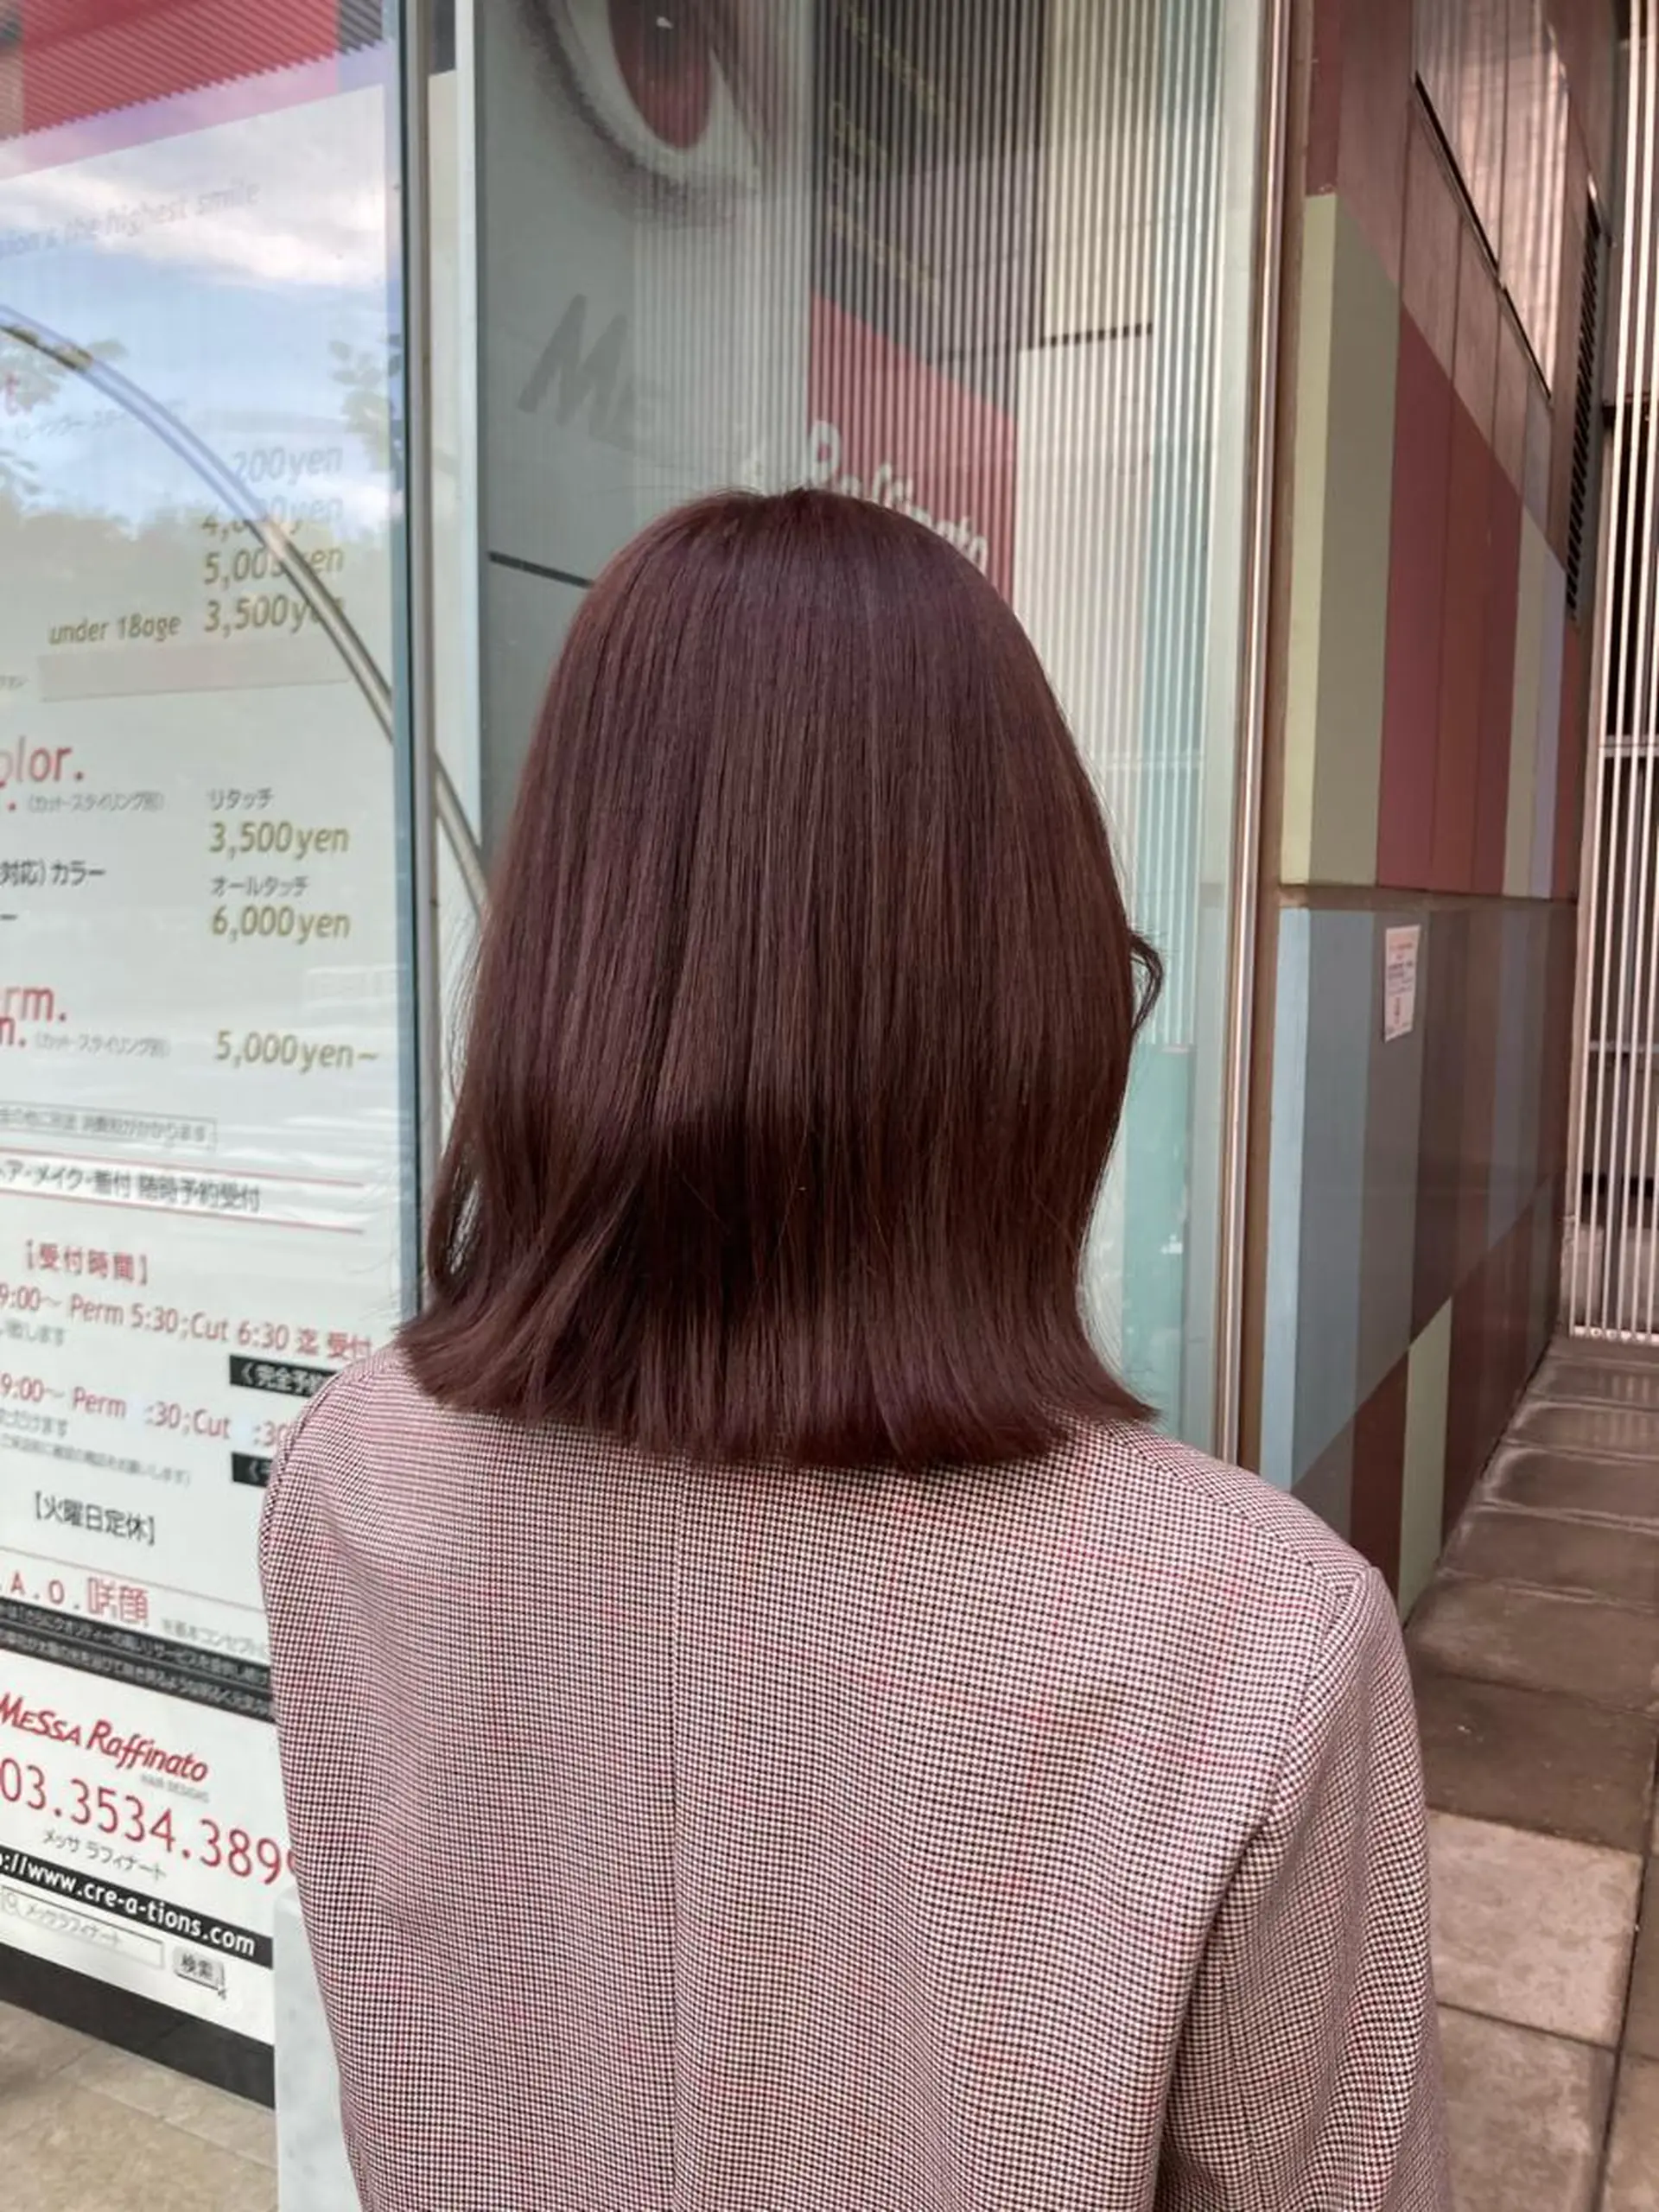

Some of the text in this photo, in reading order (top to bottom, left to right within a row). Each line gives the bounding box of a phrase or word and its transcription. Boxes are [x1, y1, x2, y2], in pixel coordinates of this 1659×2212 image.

[49, 619, 109, 645] under
[209, 821, 350, 860] 3,500yen
[211, 905, 352, 944] 6,000yen
[70, 1294, 124, 1327] Perm
[237, 1320, 290, 1352] 6:30
[73, 1386, 127, 1419] Perm
[86, 1719, 209, 1783] Raffinato
[0, 1758, 296, 1885] 03.3534.389
